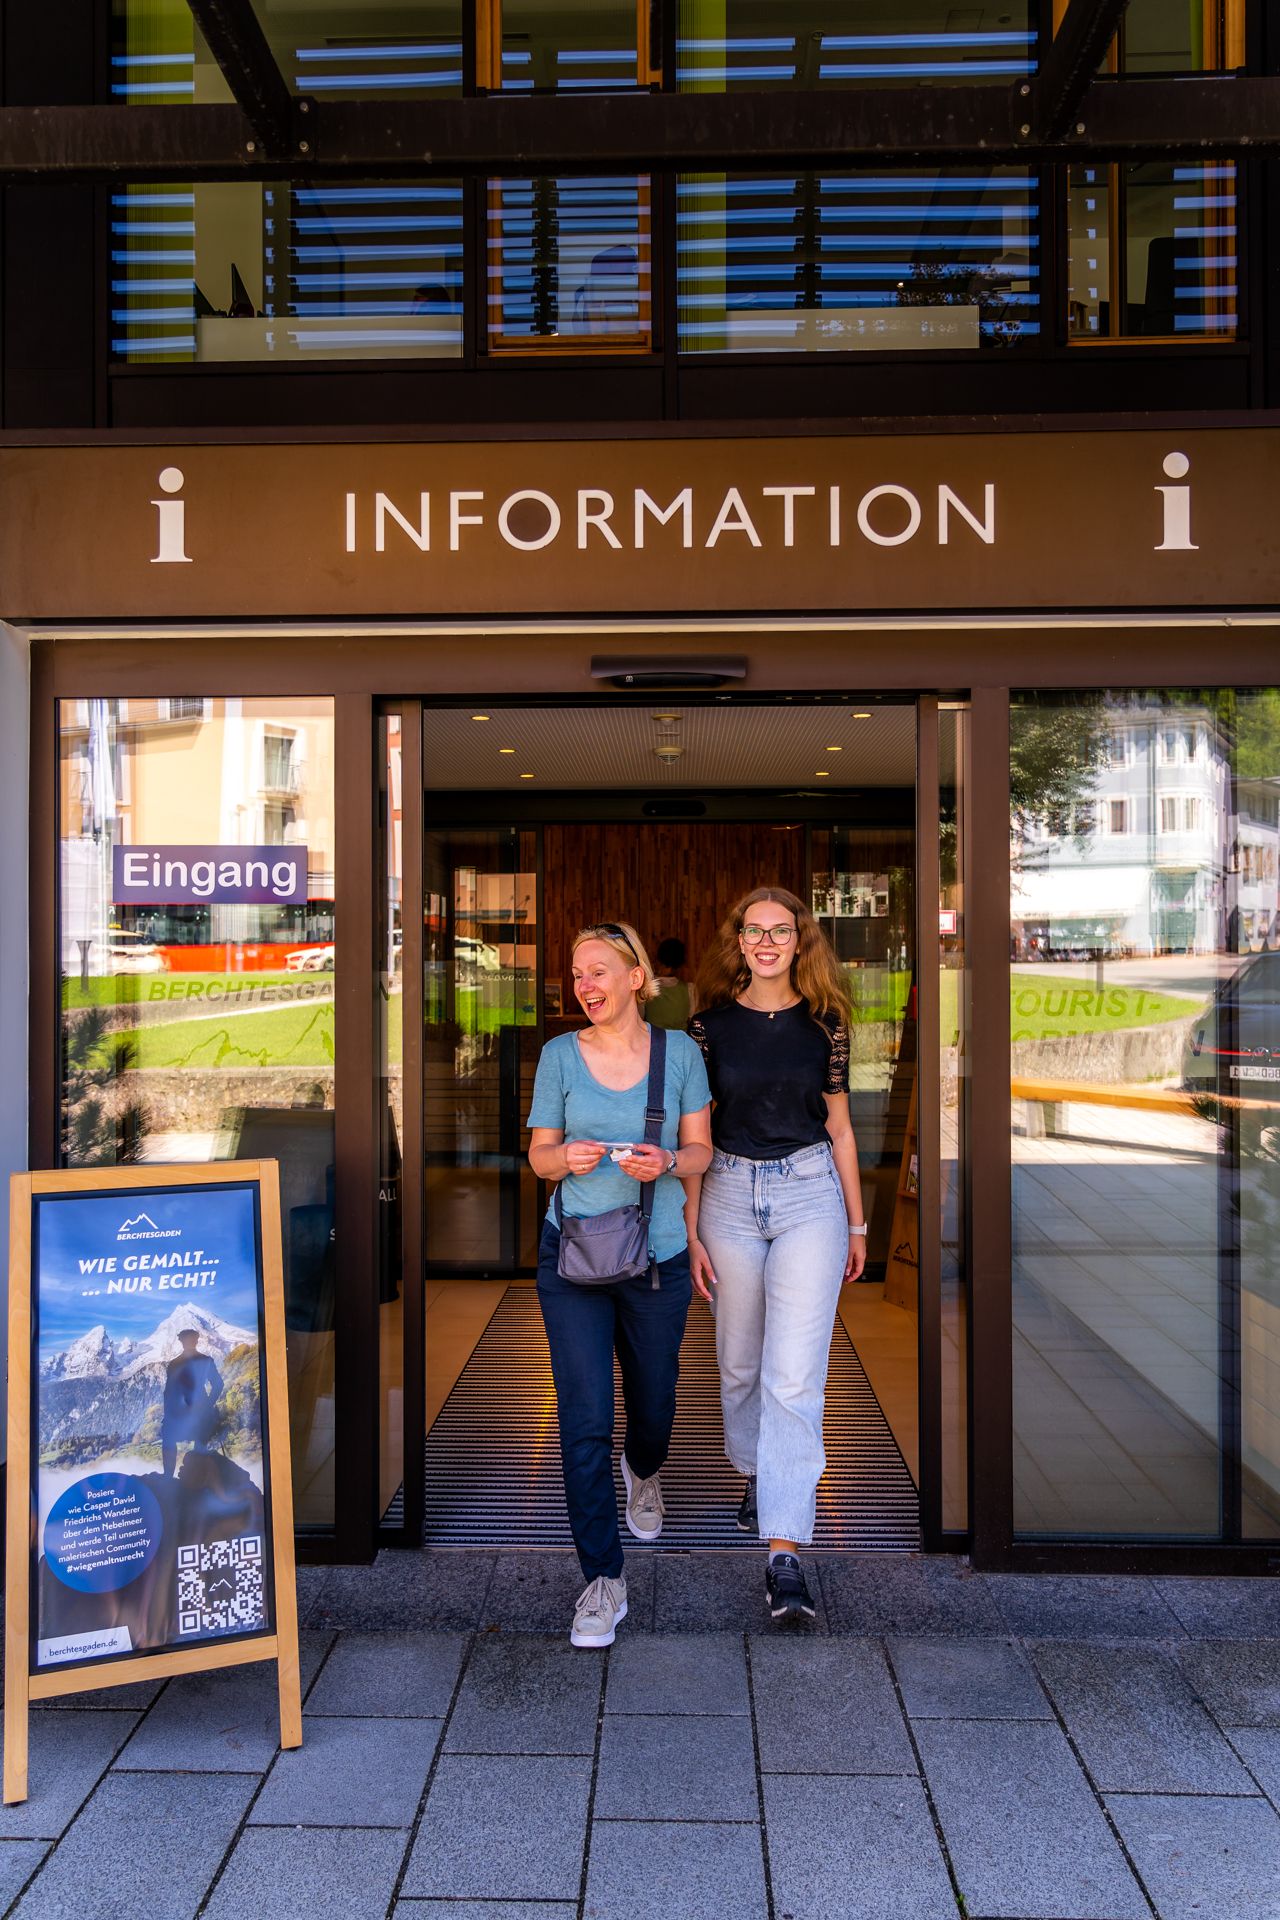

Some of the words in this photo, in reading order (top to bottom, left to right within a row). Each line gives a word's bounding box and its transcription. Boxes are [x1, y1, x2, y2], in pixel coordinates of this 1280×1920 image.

[346, 483, 995, 553] INFORMATION
[123, 852, 297, 896] Eingang
[1011, 988, 1161, 1017] OURIST-
[116, 1229, 182, 1241] BERCHTESGADEN
[79, 1257, 118, 1275] WIE
[123, 1250, 220, 1271] GEMALT...
[107, 1276, 153, 1294] NUR
[158, 1270, 217, 1290] ECHT!
[67, 1506, 81, 1515] wie
[83, 1501, 111, 1512] Caspar
[113, 1494, 136, 1506] David
[87, 1489, 115, 1499] Posiere
[63, 1529, 81, 1539] über
[83, 1526, 100, 1535] dem
[102, 1517, 143, 1531] Nebelmeer
[64, 1513, 102, 1527] Friedrichs
[103, 1506, 141, 1519] Wanderer
[58, 1546, 105, 1563] malerischen
[106, 1538, 151, 1553] Community
[60, 1541, 76, 1551] und
[78, 1536, 102, 1547] werde
[104, 1532, 117, 1542] Teil
[119, 1528, 147, 1539] unserer
[66, 1550, 145, 1573] #wiegemaltnurecht
[49, 1638, 118, 1657] berchtesgaden.de
